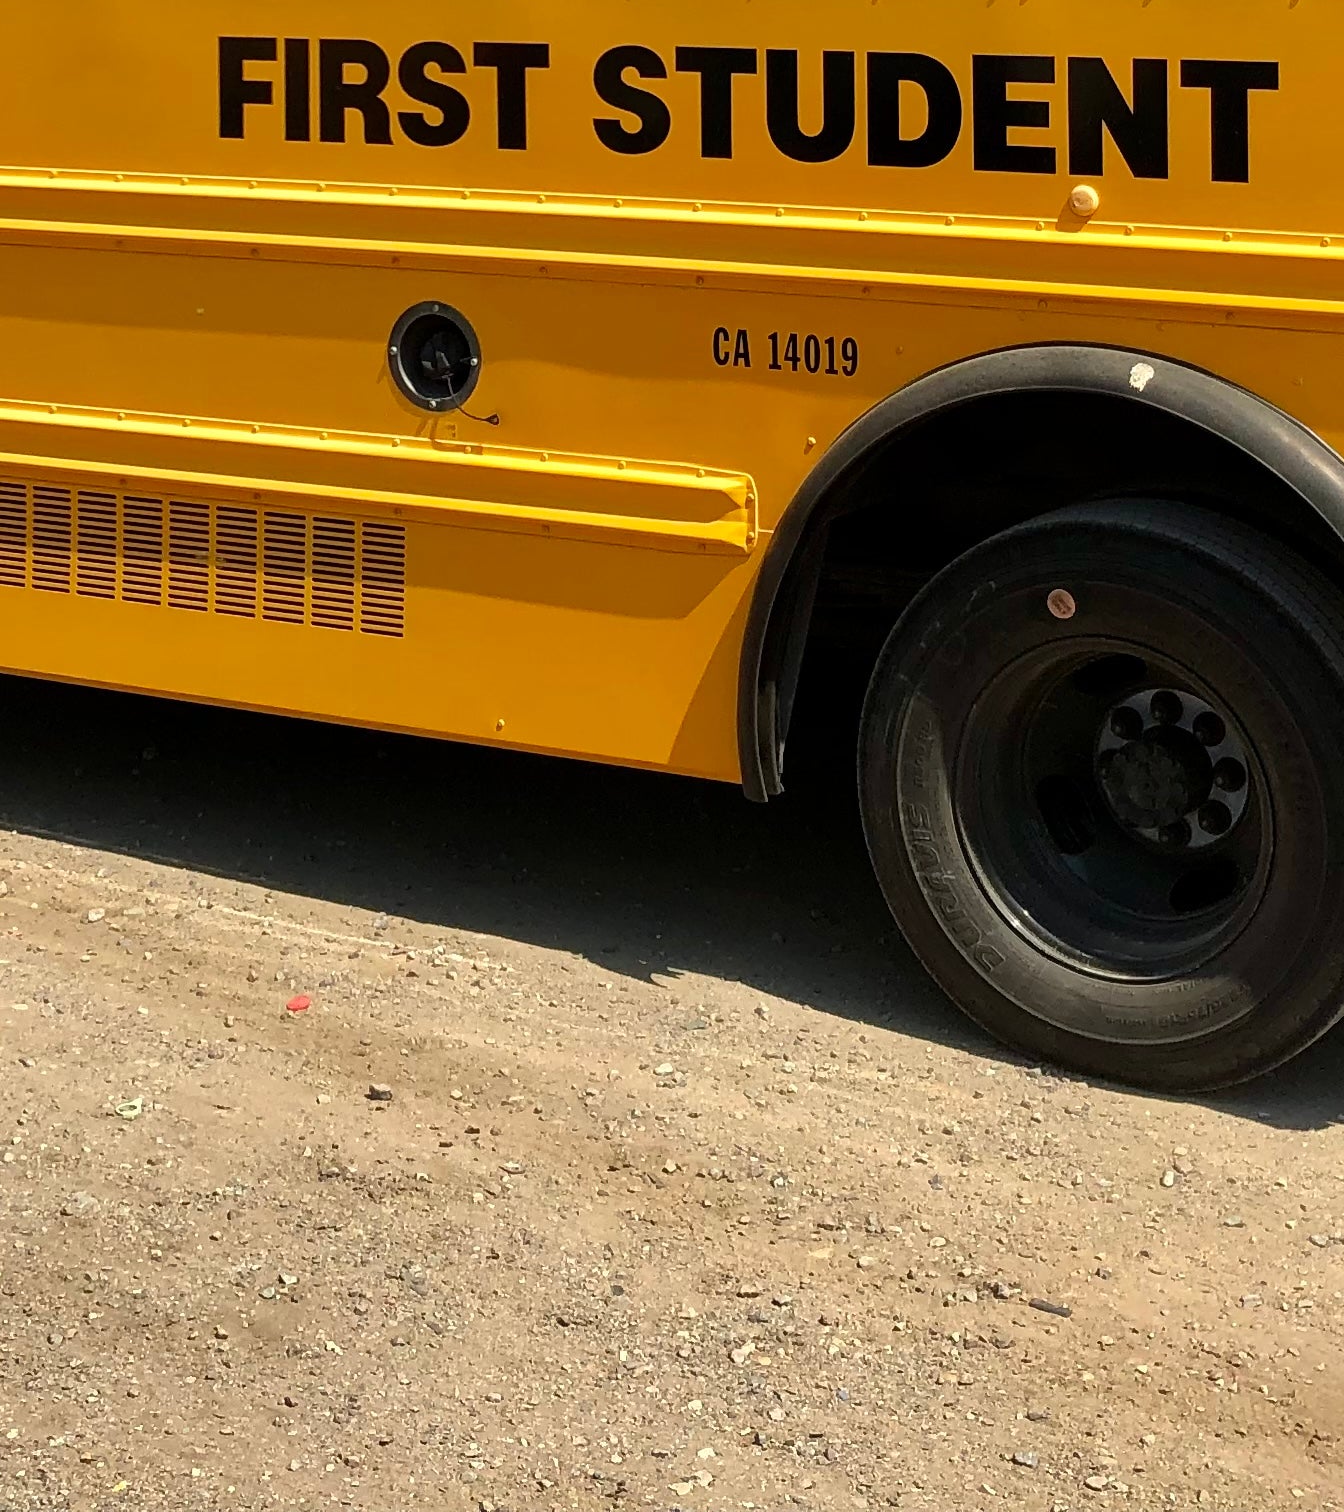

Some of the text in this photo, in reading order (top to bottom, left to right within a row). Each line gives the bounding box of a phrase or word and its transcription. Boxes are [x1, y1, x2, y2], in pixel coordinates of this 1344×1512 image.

[218, 36, 1280, 184] FIRST STUDENT
[713, 326, 858, 377] CA 14019
